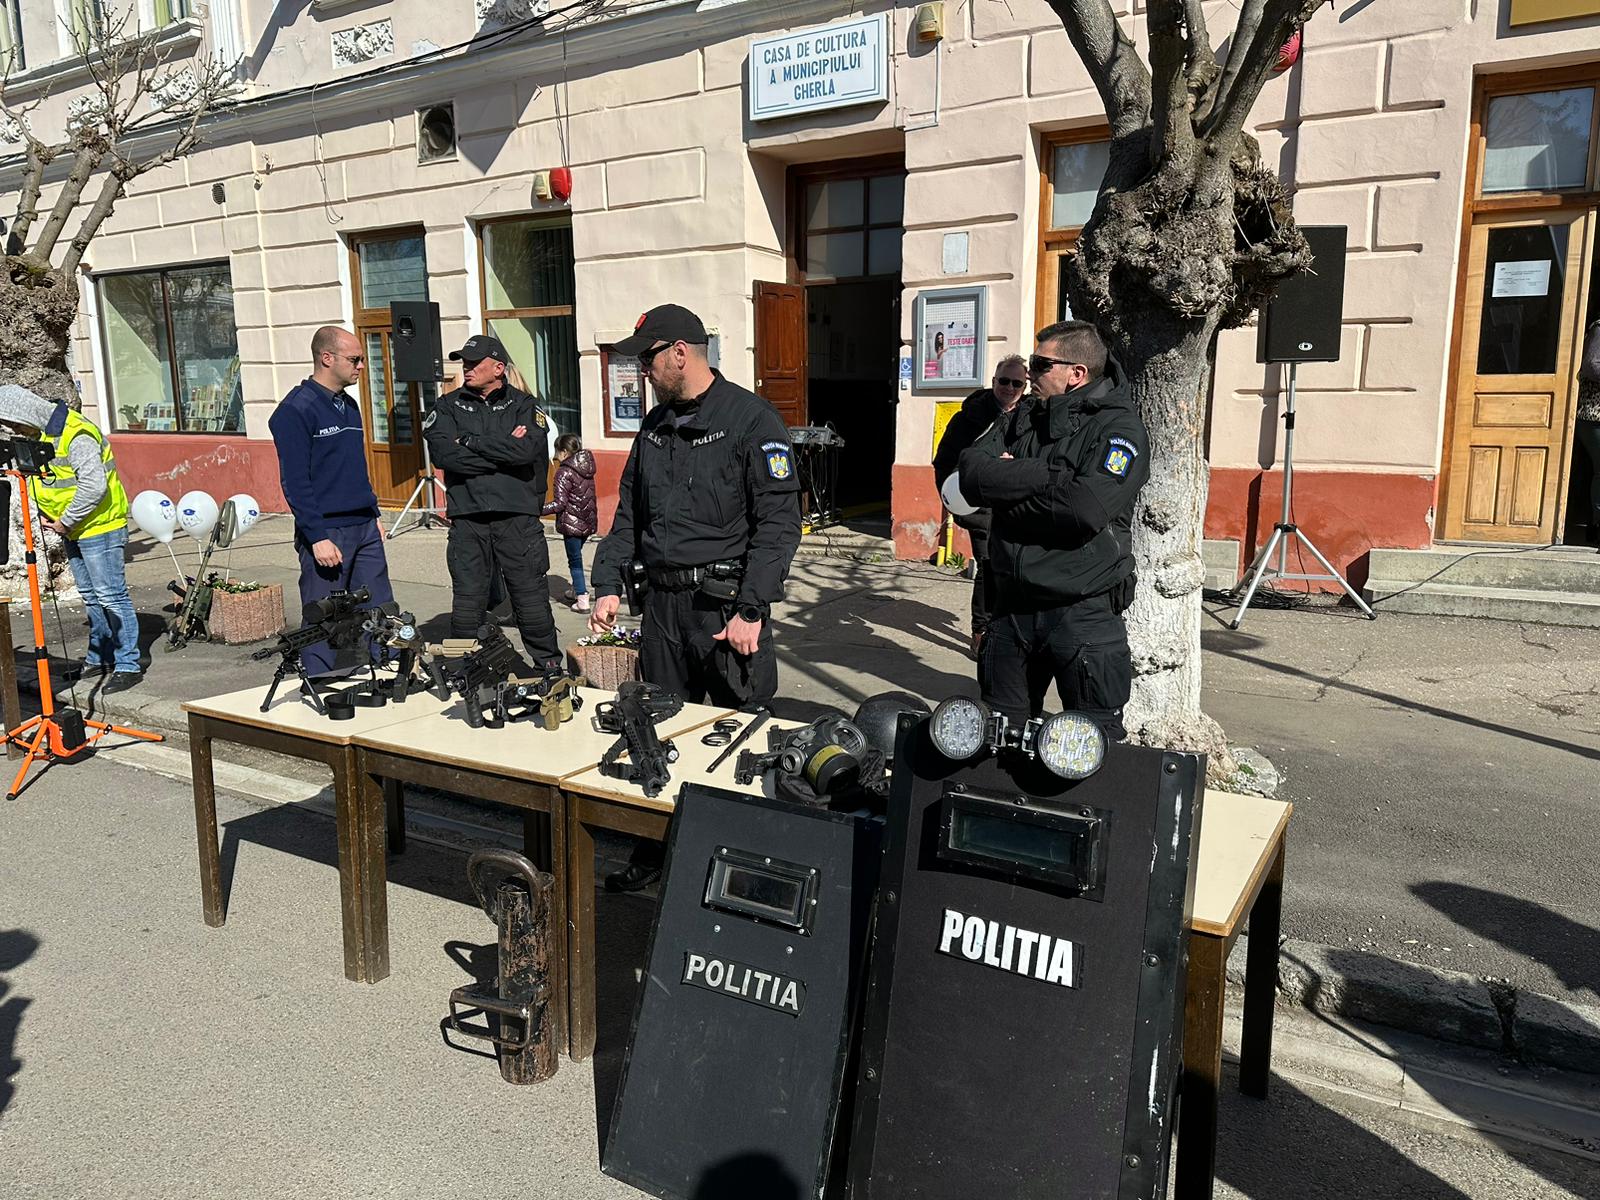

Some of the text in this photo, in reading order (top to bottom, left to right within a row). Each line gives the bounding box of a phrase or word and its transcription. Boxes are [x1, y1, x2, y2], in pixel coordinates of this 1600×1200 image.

[764, 45, 791, 65] CASA
[797, 41, 810, 59] DE
[770, 53, 861, 85] A MUNICIPIULUI
[794, 78, 835, 101] GHERLA
[939, 909, 1073, 987] POLITIA
[686, 954, 798, 1011] POLITIA
